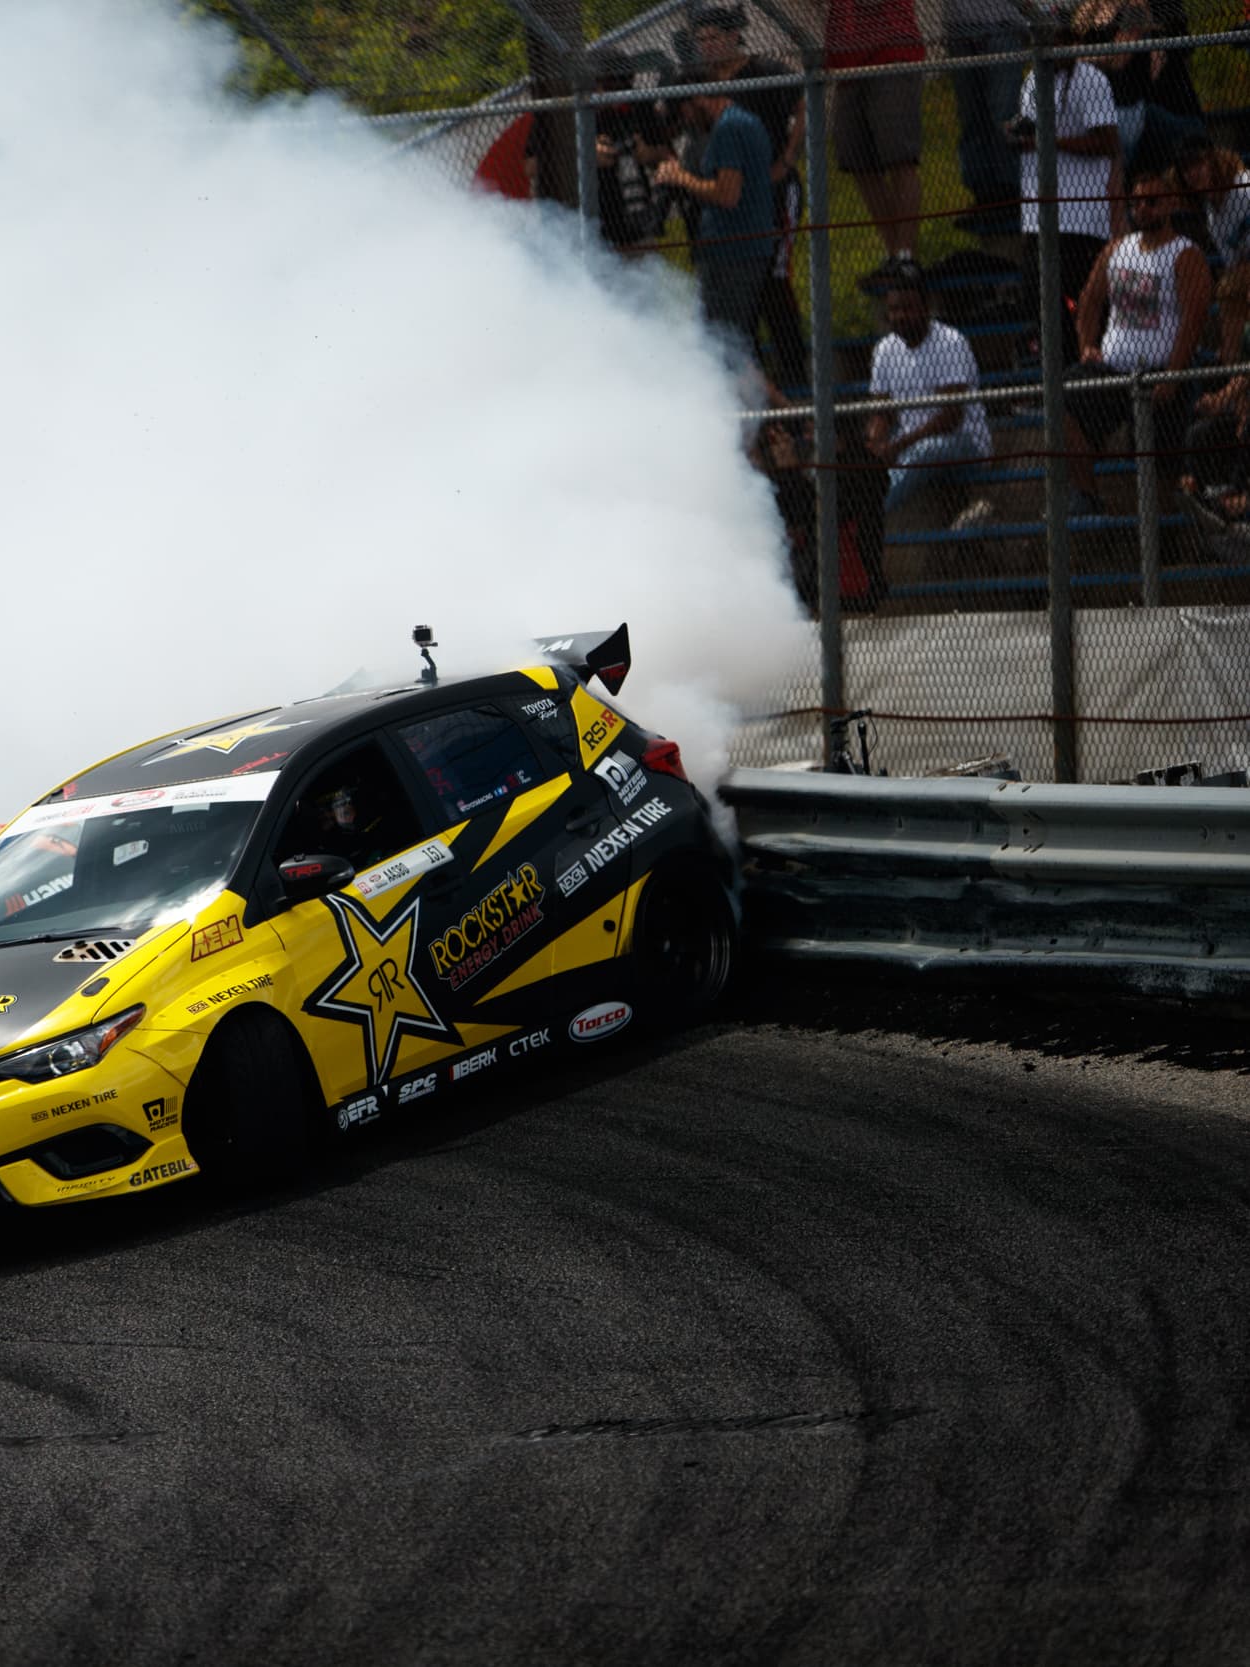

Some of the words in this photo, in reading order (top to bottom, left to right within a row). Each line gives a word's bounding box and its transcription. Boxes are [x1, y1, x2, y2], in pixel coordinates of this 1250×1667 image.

[521, 698, 556, 715] TOYOTA
[617, 768, 643, 799] MOTEGI
[623, 777, 648, 806] RACING
[583, 819, 644, 872] NEXEN
[632, 797, 672, 827] TIRE
[422, 845, 445, 864] 151
[284, 863, 322, 878] TRD
[430, 864, 542, 975] ROCKSTAR
[191, 914, 244, 962] AEM
[450, 935, 499, 987] ENERGY
[502, 901, 541, 940] DRINK
[207, 984, 250, 1004] NEXEN
[248, 973, 274, 989] TIRE
[576, 1004, 625, 1034] Torco
[509, 1028, 551, 1057] CTEK
[459, 1048, 497, 1076] BERK
[400, 1073, 437, 1098] SPC
[51, 1099, 91, 1117] NEXEN
[93, 1089, 118, 1104] TIRE
[347, 1095, 379, 1123] EFR
[129, 1158, 190, 1187] GATEBIL
